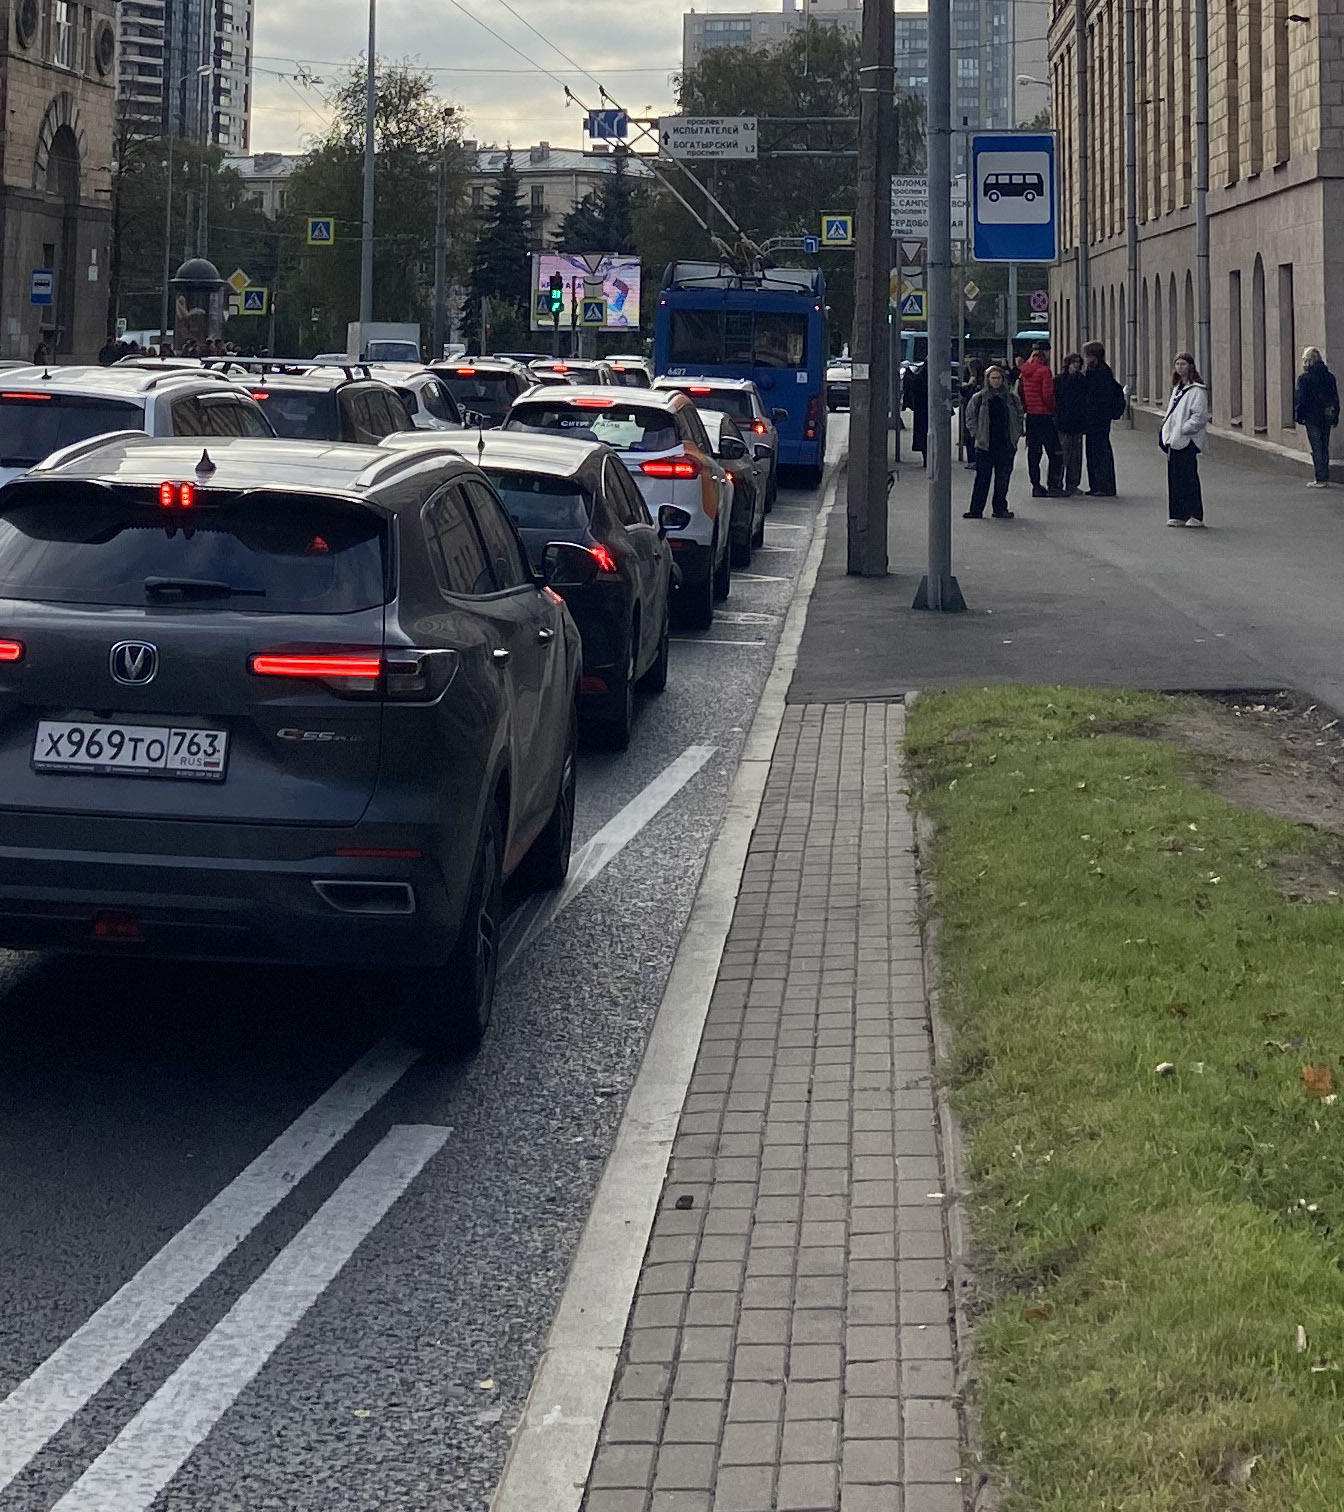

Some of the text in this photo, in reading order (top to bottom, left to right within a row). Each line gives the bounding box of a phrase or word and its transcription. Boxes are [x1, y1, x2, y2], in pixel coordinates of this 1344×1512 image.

[672, 125, 739, 135] ИСПЫТАТЕЛЕЙ
[673, 139, 739, 149] БОГАТЫРСКИЙ
[44, 727, 219, 762] Х969ТО 763
[180, 756, 204, 767] RUS
